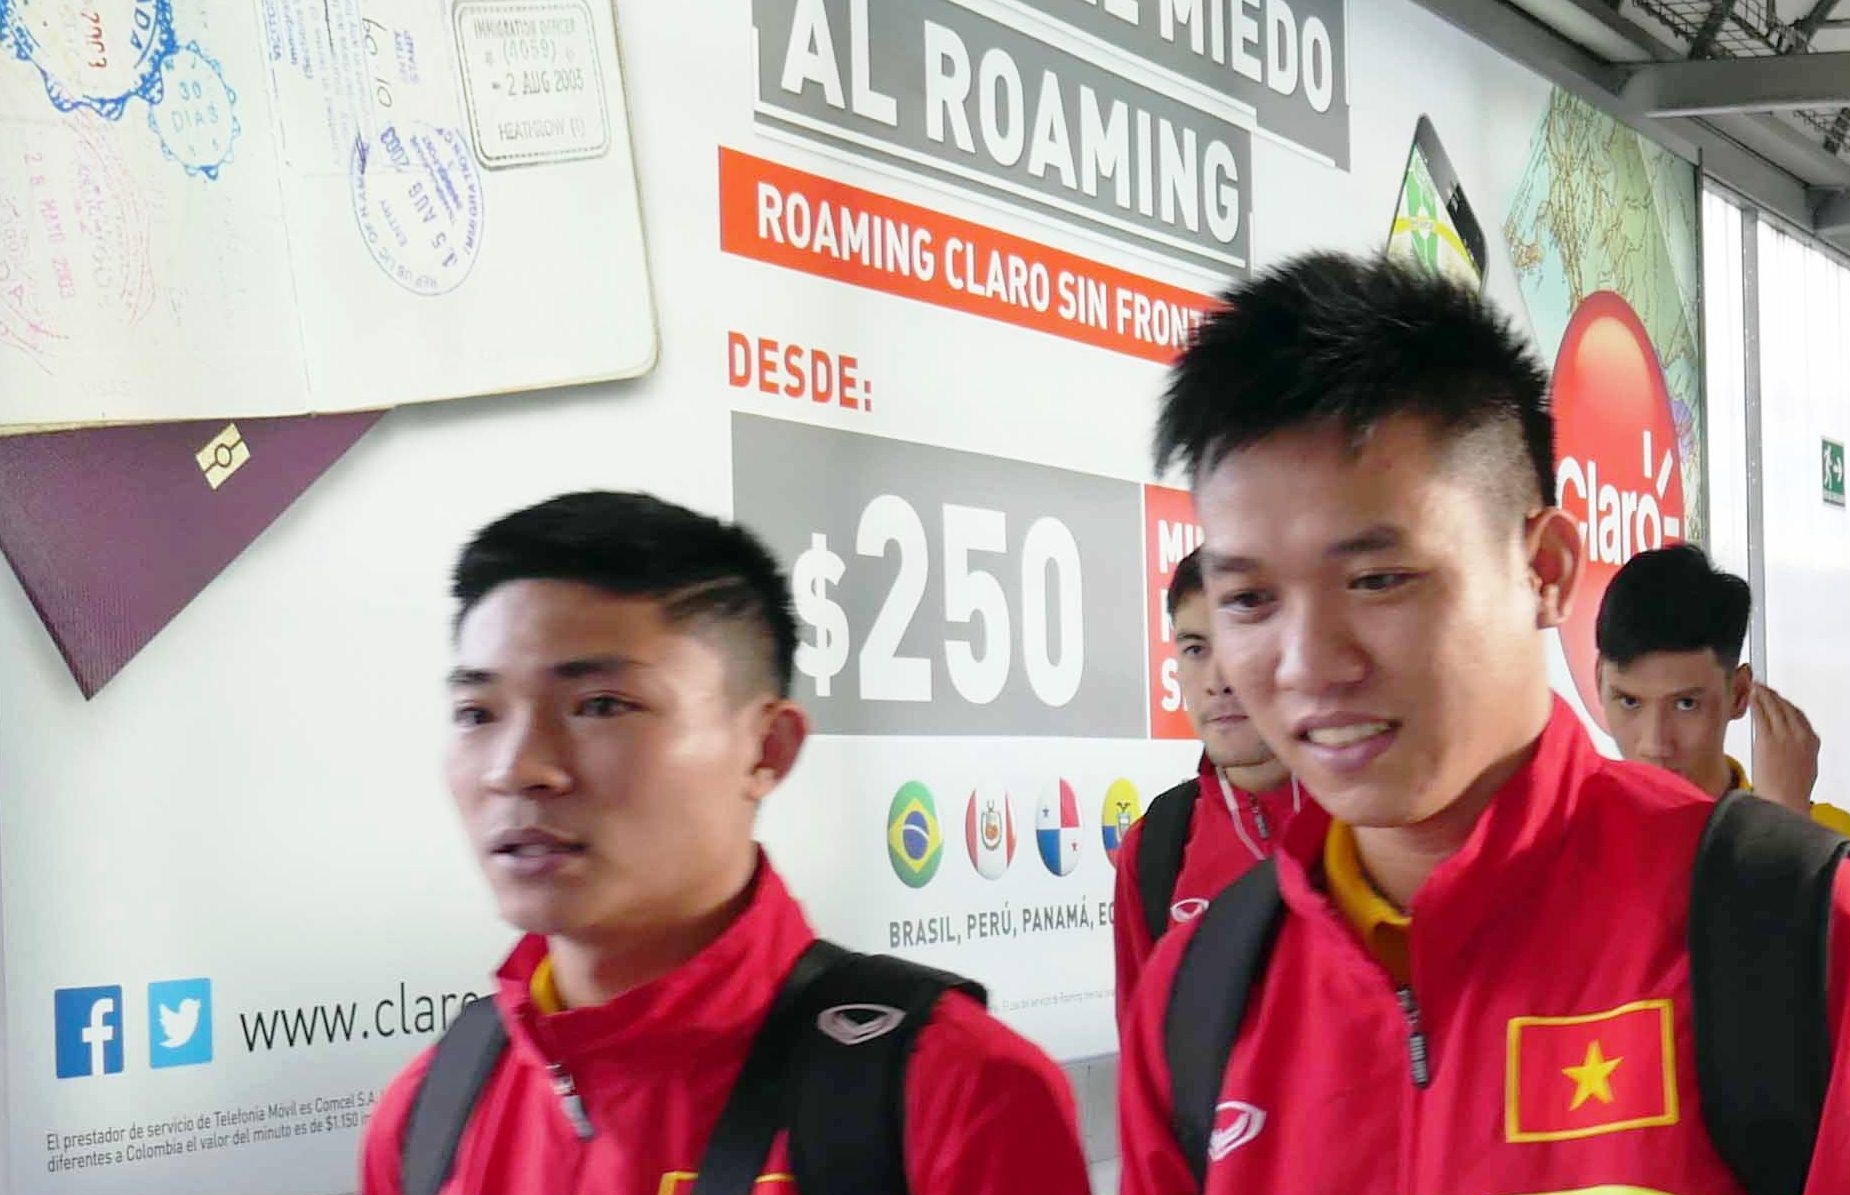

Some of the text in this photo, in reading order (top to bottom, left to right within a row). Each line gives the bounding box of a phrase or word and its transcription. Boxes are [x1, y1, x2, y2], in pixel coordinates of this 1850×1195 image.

[523, 70, 550, 95] AUG
[781, 0, 1240, 243] AL ROAMING
[757, 181, 1205, 352] ROAMING CLARO SIN FRONT
[727, 331, 873, 412] DESDE:
[1556, 455, 1662, 566] Claro
[792, 494, 1084, 708] $250
[890, 916, 961, 948] BRASIL,
[967, 901, 1017, 939] PERÚ,
[1022, 895, 1094, 933] PANAMÁ,
[240, 981, 480, 1052] www.clar
[46, 1132, 60, 1151] El
[64, 1127, 126, 1152] prestador
[129, 1121, 144, 1140] de
[147, 1117, 194, 1137] servicio
[197, 1113, 211, 1130] de
[300, 1103, 313, 1116] es
[315, 1095, 354, 1113] Comcel
[48, 1152, 113, 1173] diferentes
[115, 1150, 123, 1163] a
[126, 1140, 183, 1162] Colombia
[186, 1136, 197, 1152] el
[200, 1131, 232, 1150] valor
[233, 1126, 250, 1145] del
[253, 1123, 291, 1142] minuto
[294, 1123, 307, 1136] es
[310, 1117, 323, 1133] de
